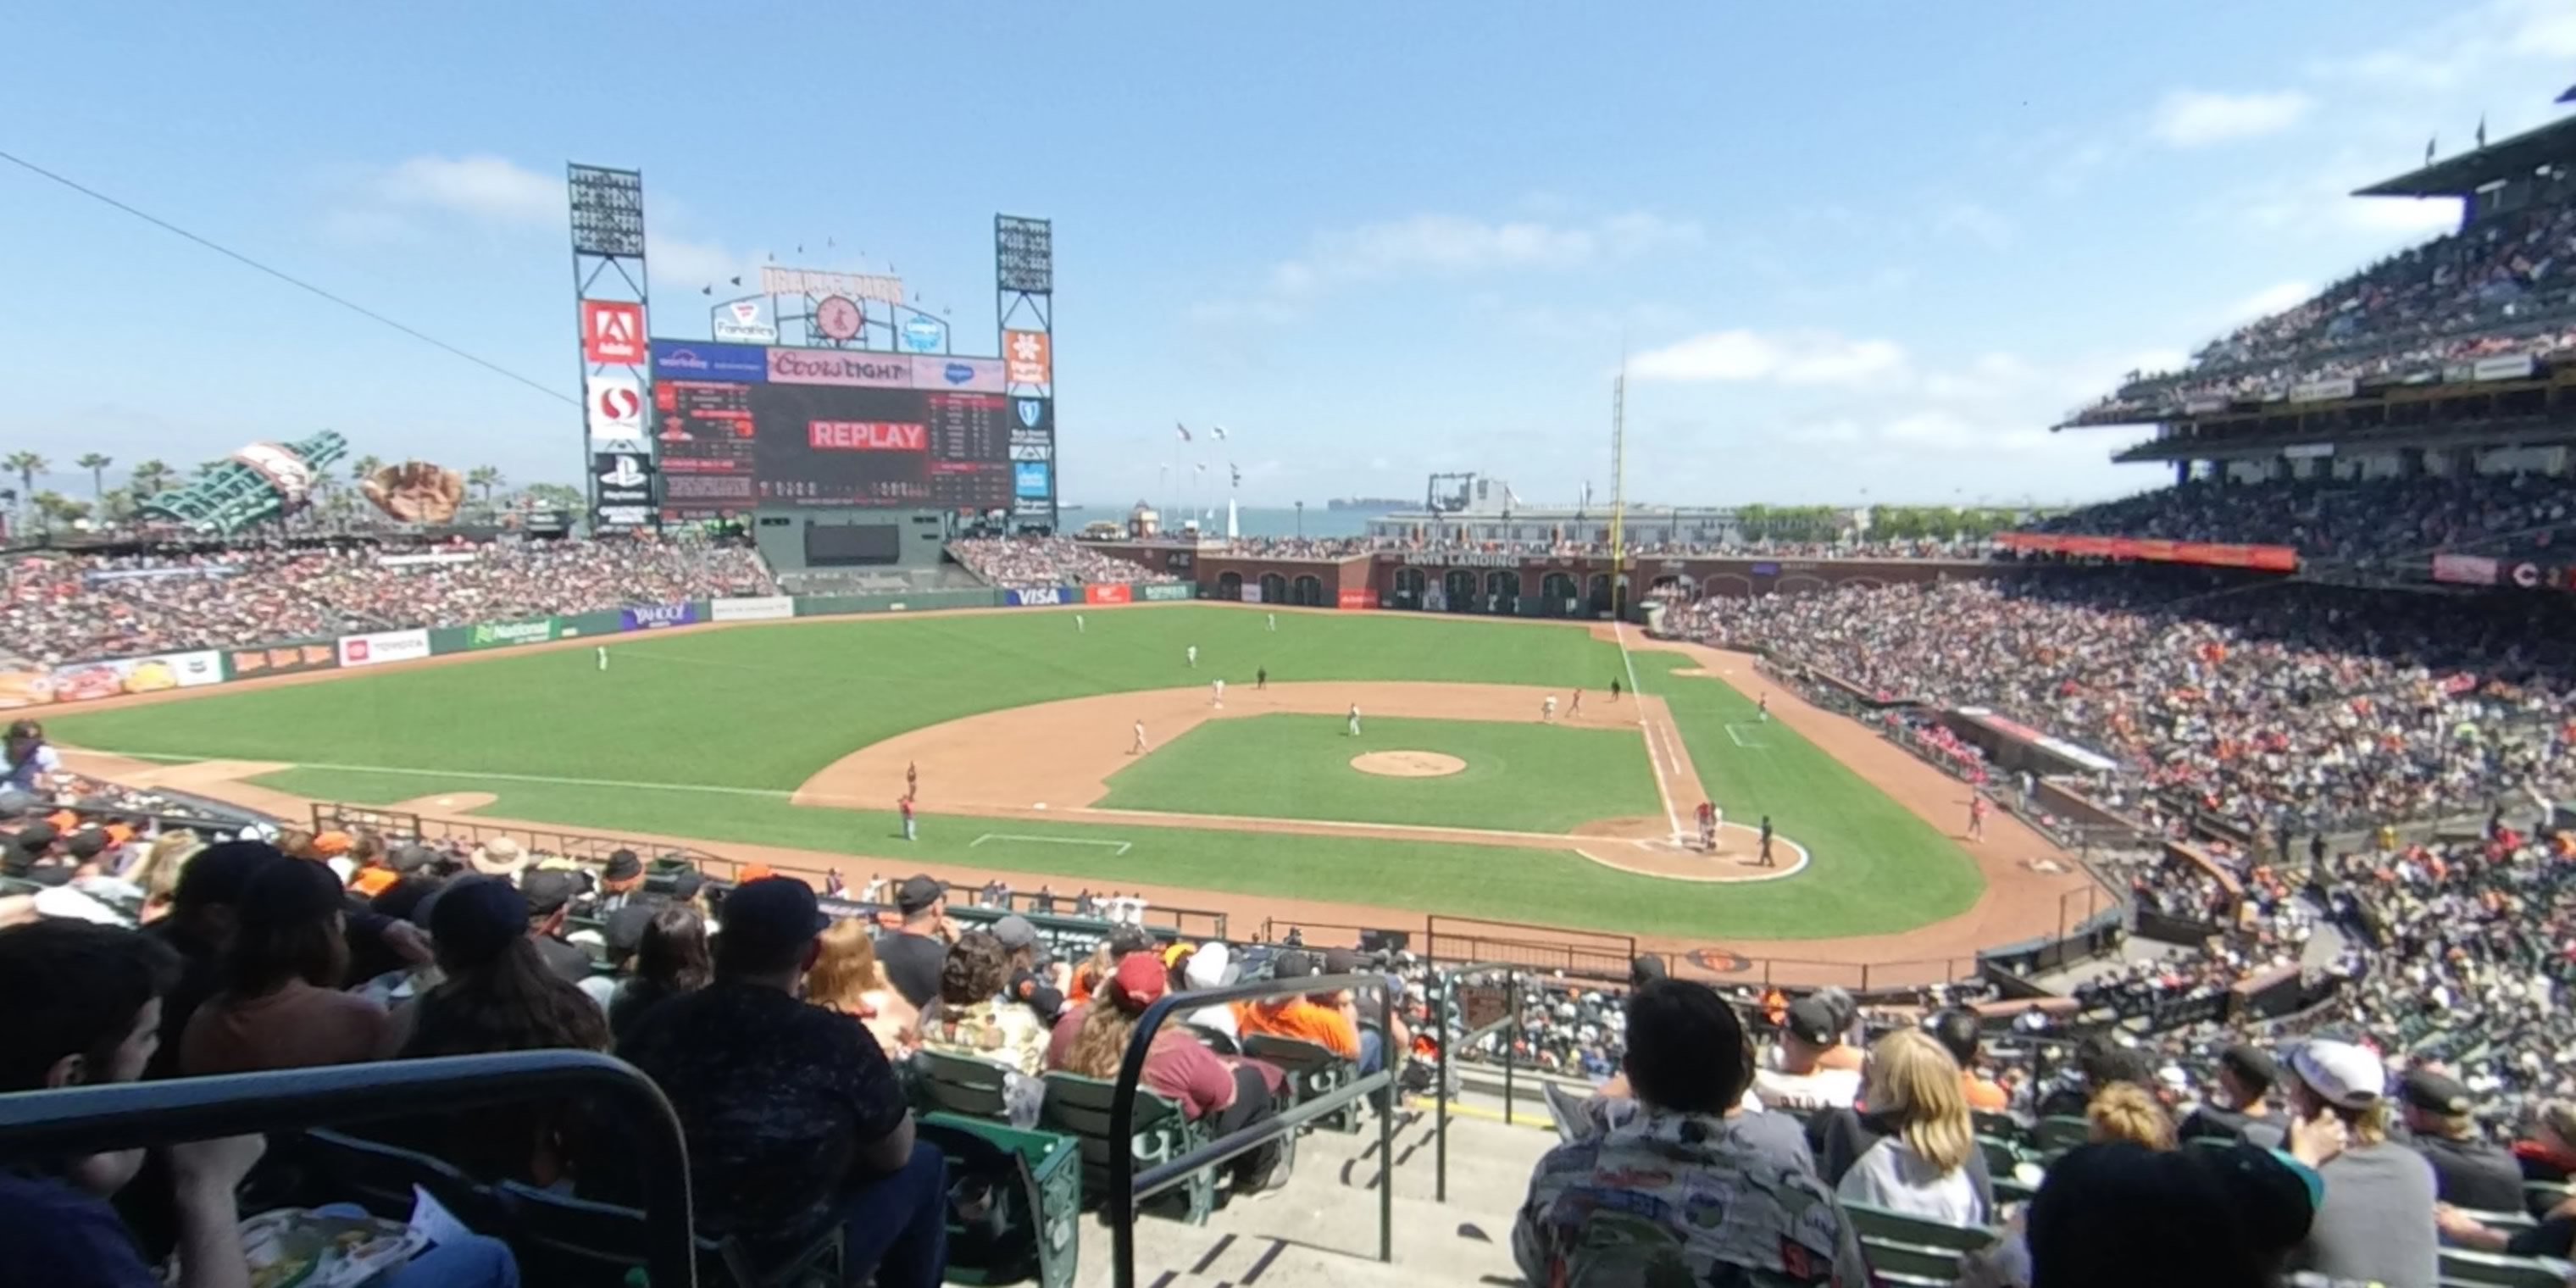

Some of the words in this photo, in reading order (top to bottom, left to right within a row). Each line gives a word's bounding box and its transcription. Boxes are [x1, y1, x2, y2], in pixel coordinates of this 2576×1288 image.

[717, 322, 775, 337] Fanatics
[774, 352, 841, 377] Coors
[843, 358, 902, 380] LIGHT
[814, 422, 924, 448] REPLAY
[1447, 553, 1519, 568] LANDING
[1017, 588, 1059, 605] VISA
[494, 620, 550, 639] National
[374, 639, 423, 652] TOYOTA
